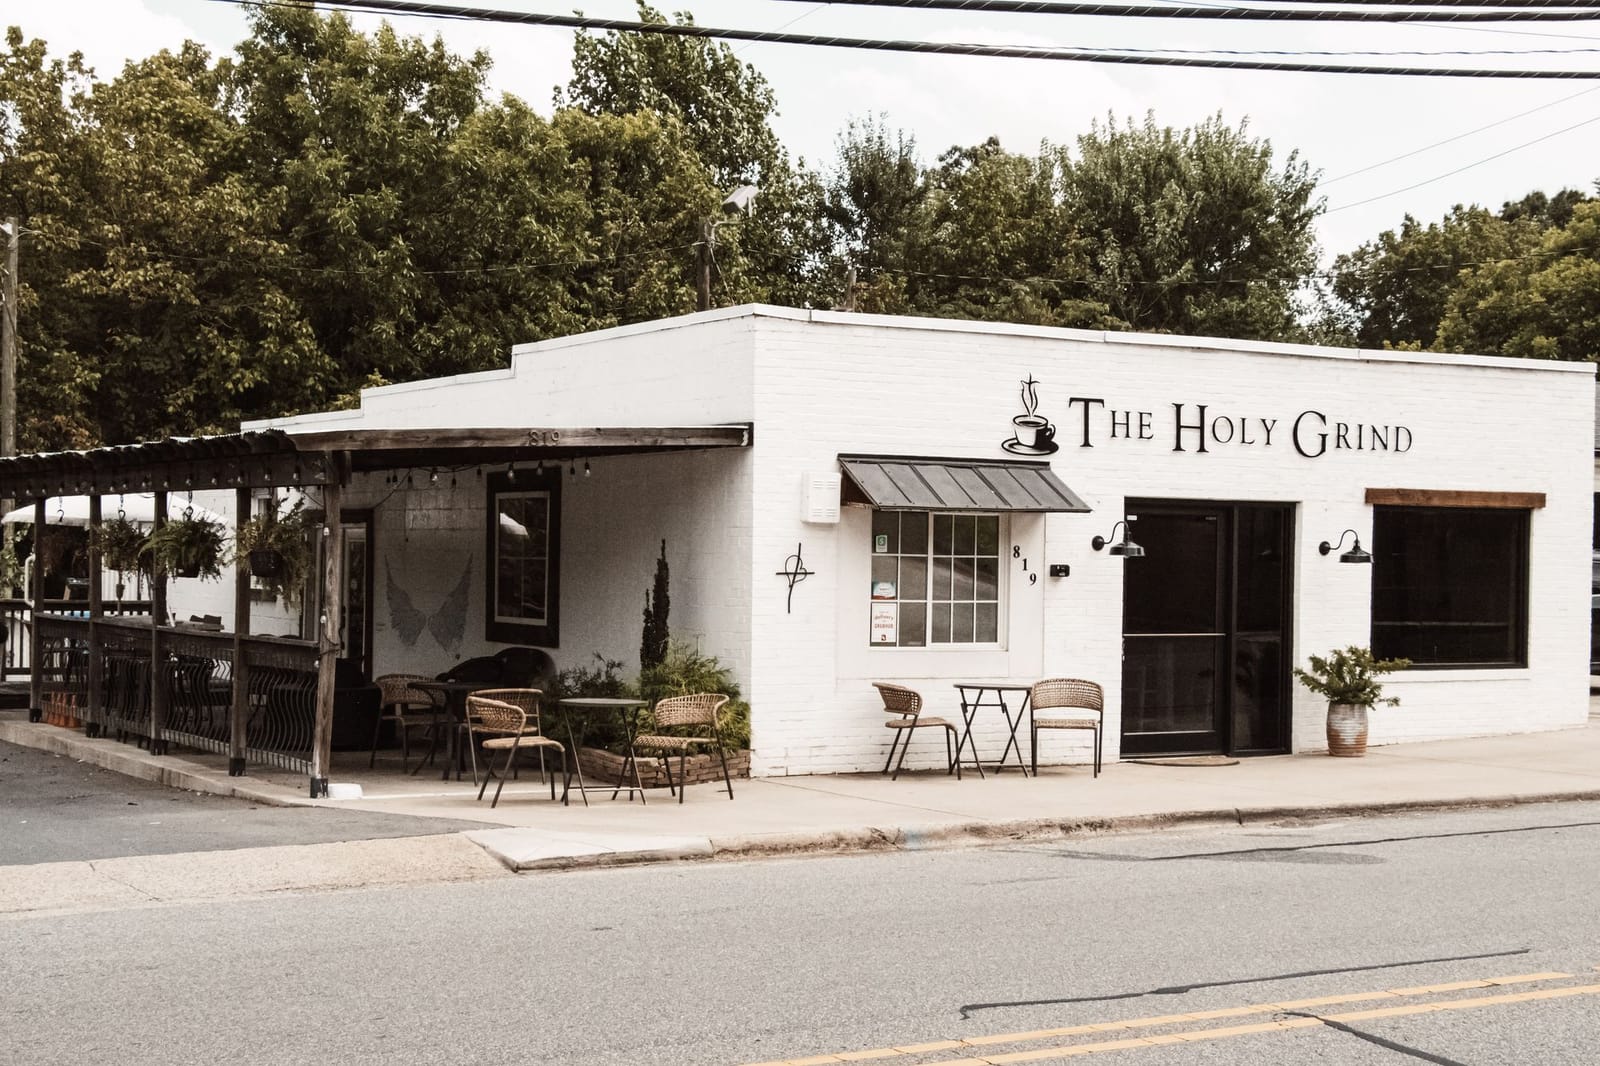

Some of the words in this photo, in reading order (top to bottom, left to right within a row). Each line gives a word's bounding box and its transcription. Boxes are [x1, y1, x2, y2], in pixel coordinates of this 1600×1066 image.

[1068, 397, 1155, 448] THE
[1171, 402, 1278, 453] HOLY
[1292, 410, 1413, 459] GRIND
